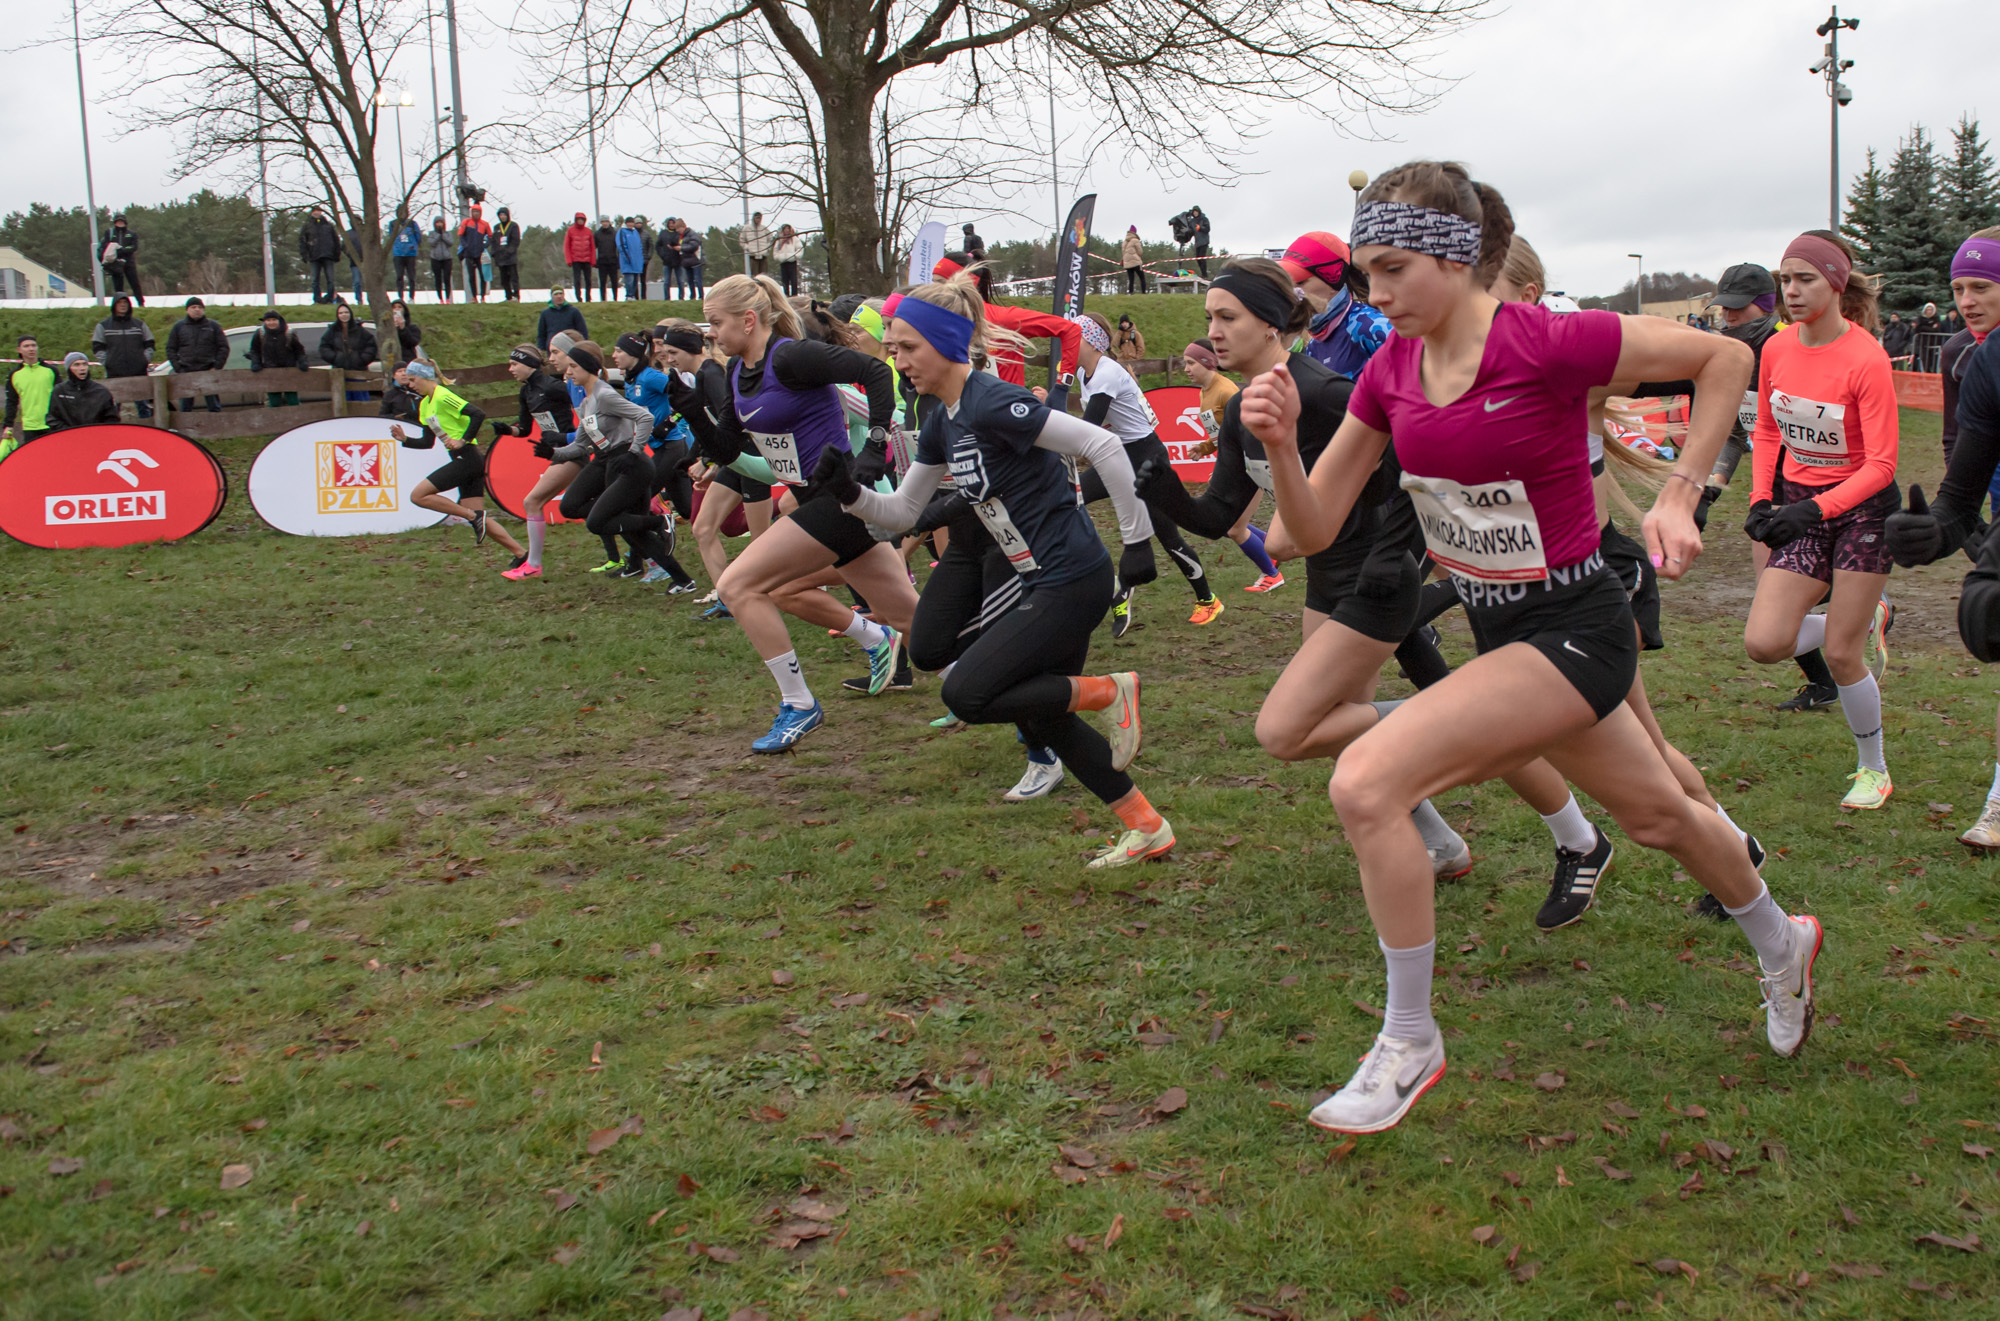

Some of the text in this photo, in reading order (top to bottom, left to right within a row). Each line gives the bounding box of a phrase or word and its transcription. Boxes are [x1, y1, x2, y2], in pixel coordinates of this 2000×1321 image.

[1776, 406, 1793, 415] ORLEN
[1816, 405, 1826, 419] 7
[765, 436, 789, 449] 456
[1777, 418, 1839, 446] PIETRAS
[53, 495, 157, 521] ORLEN
[322, 488, 394, 510] PZLA
[1461, 488, 1512, 508] 340
[1420, 511, 1537, 555] MIKOŁAJEWSKA
